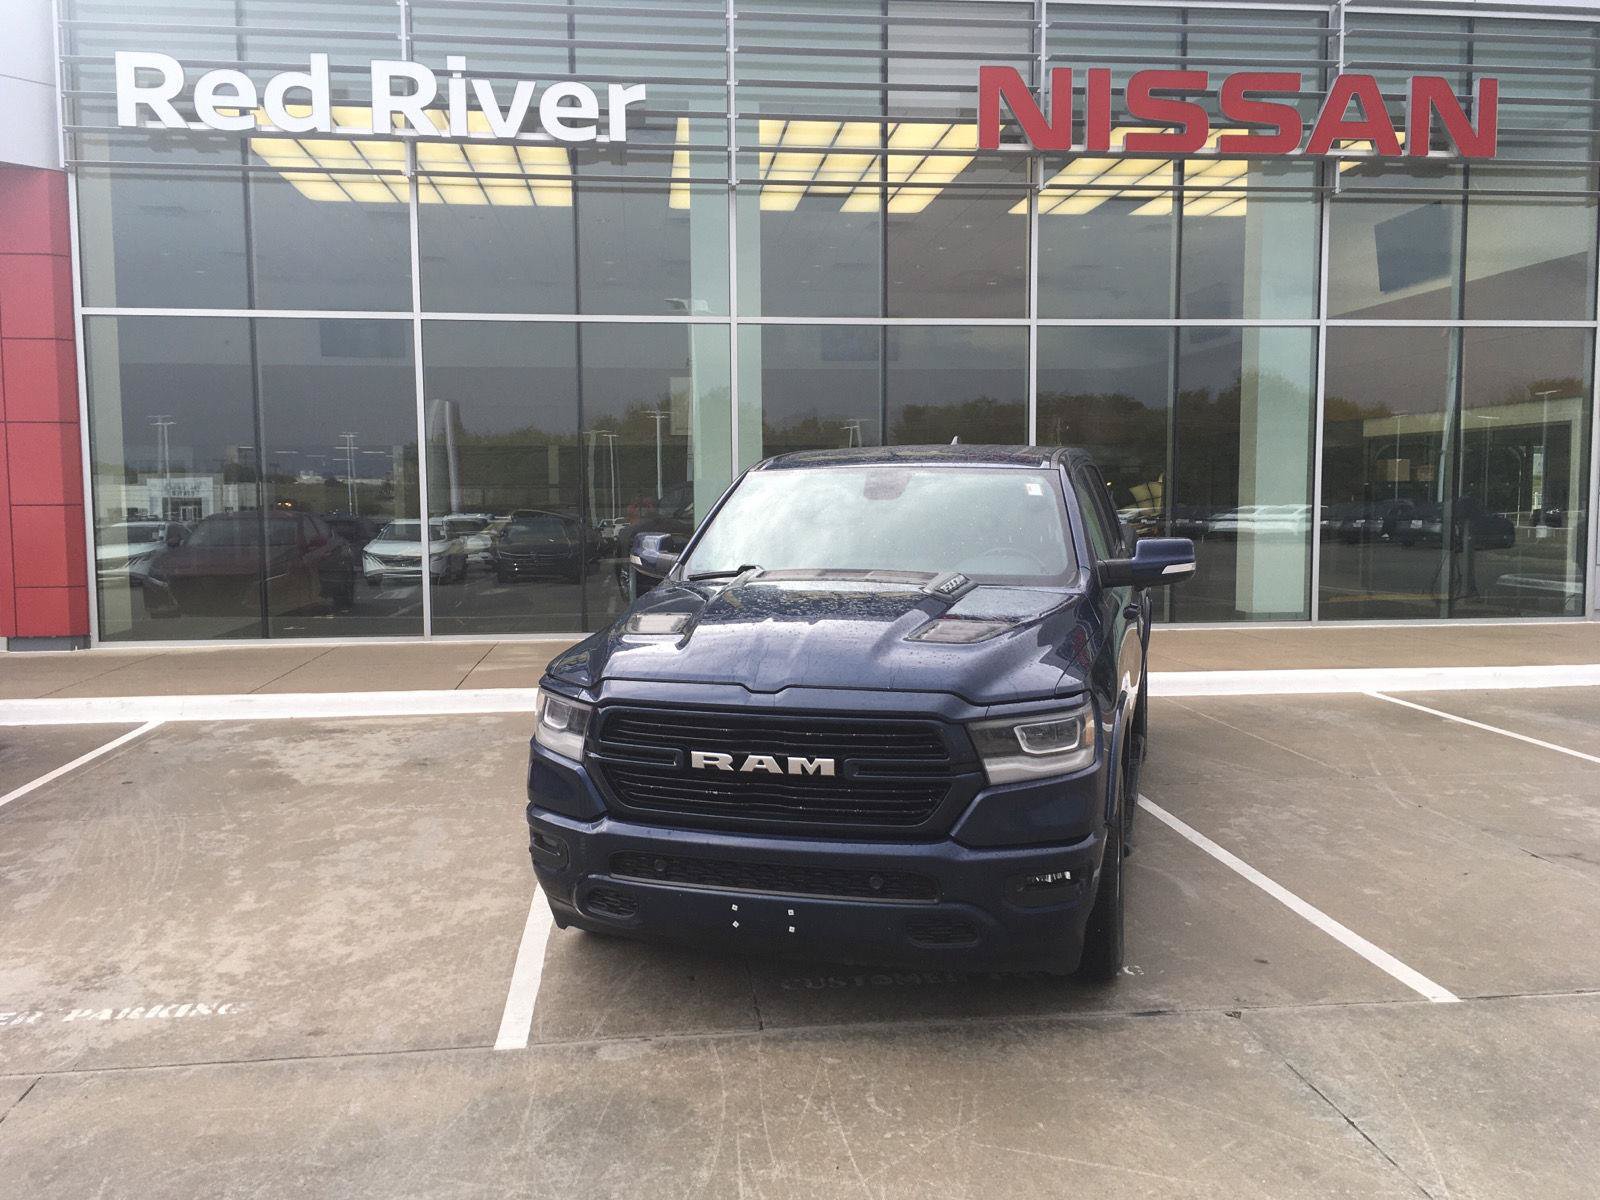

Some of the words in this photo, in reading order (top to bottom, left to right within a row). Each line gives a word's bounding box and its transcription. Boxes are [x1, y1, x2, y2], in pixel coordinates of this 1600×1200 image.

[115, 51, 331, 133] Red
[370, 55, 646, 142] River
[978, 65, 1498, 158] NISSAN
[690, 750, 835, 776] RAM
